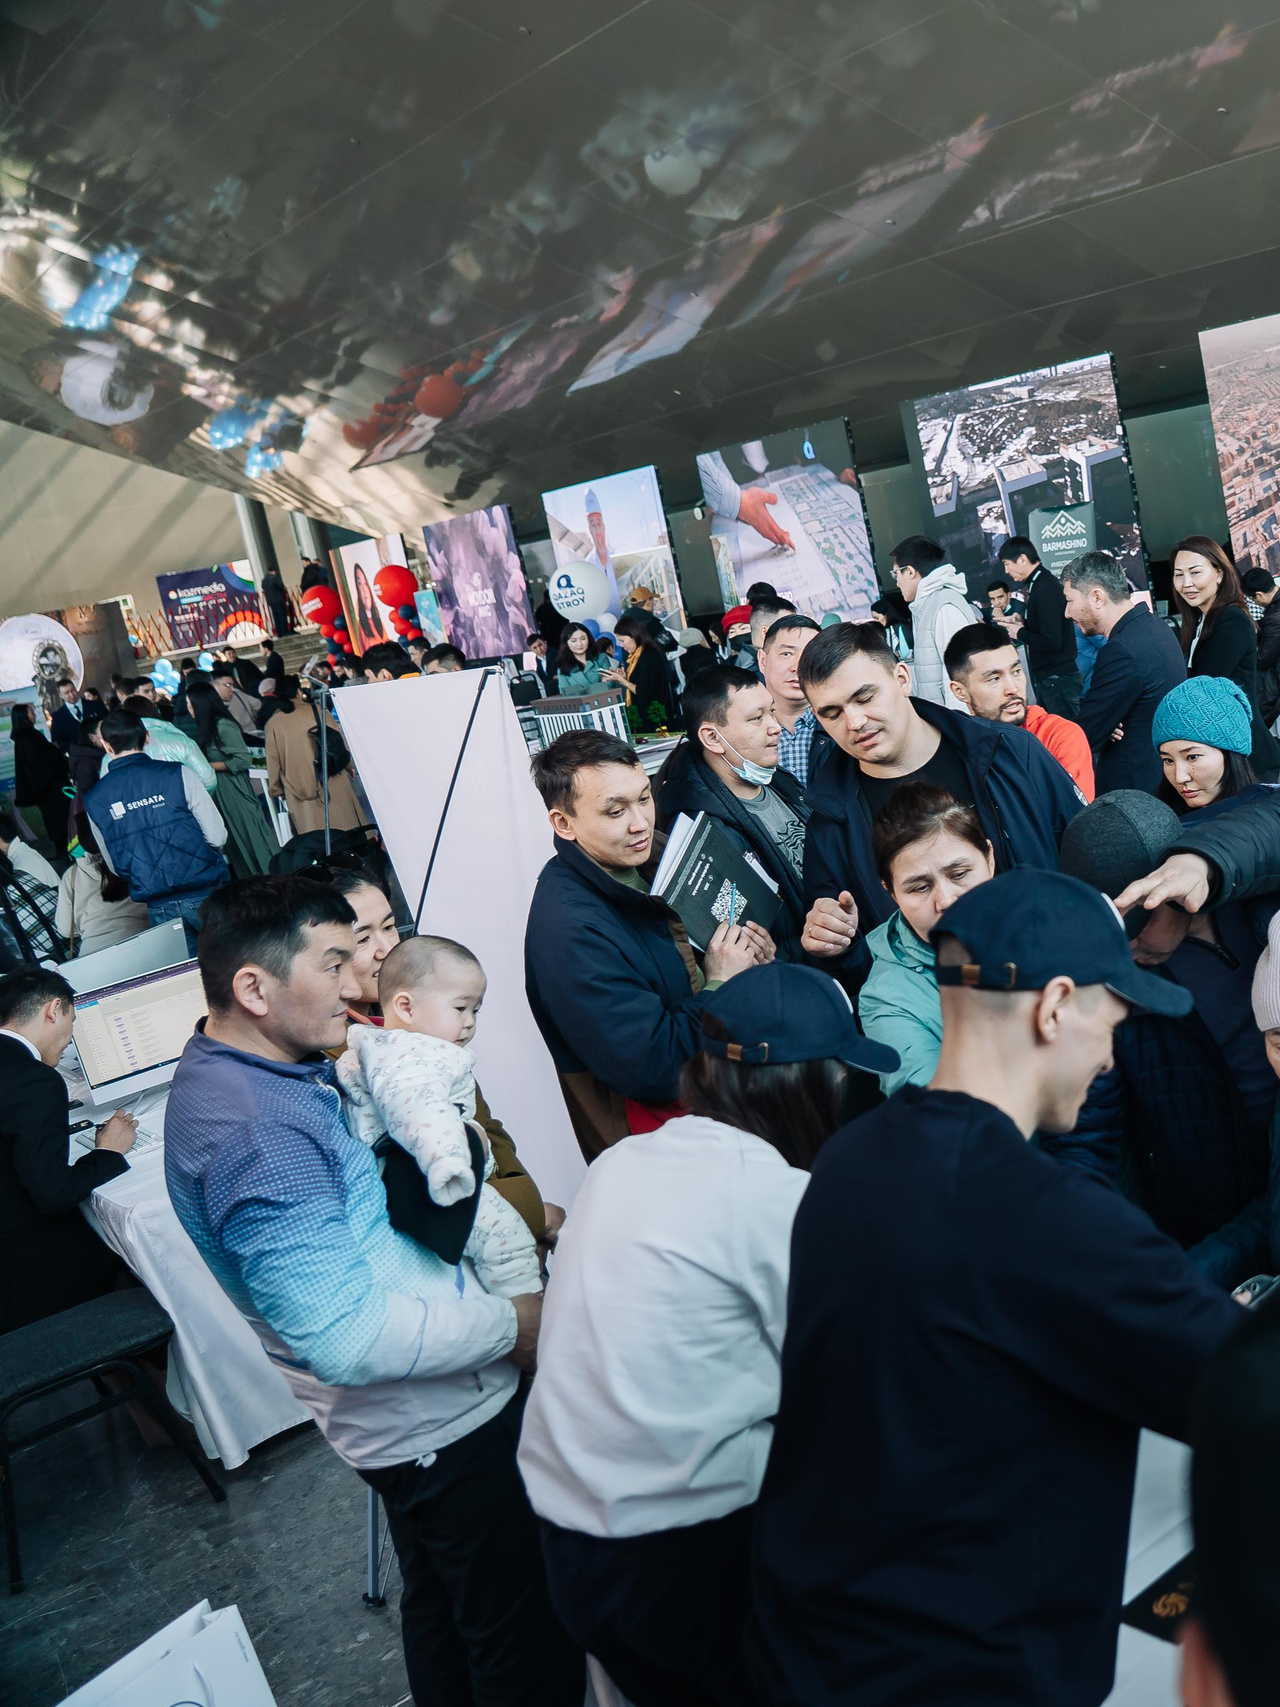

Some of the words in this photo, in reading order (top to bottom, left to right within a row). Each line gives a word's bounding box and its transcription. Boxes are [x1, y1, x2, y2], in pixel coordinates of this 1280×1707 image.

[1042, 538, 1087, 552] BARMASHINO
[552, 586, 586, 602] QAZAQ
[555, 595, 586, 610] STROY
[126, 794, 166, 811] SENSATA
